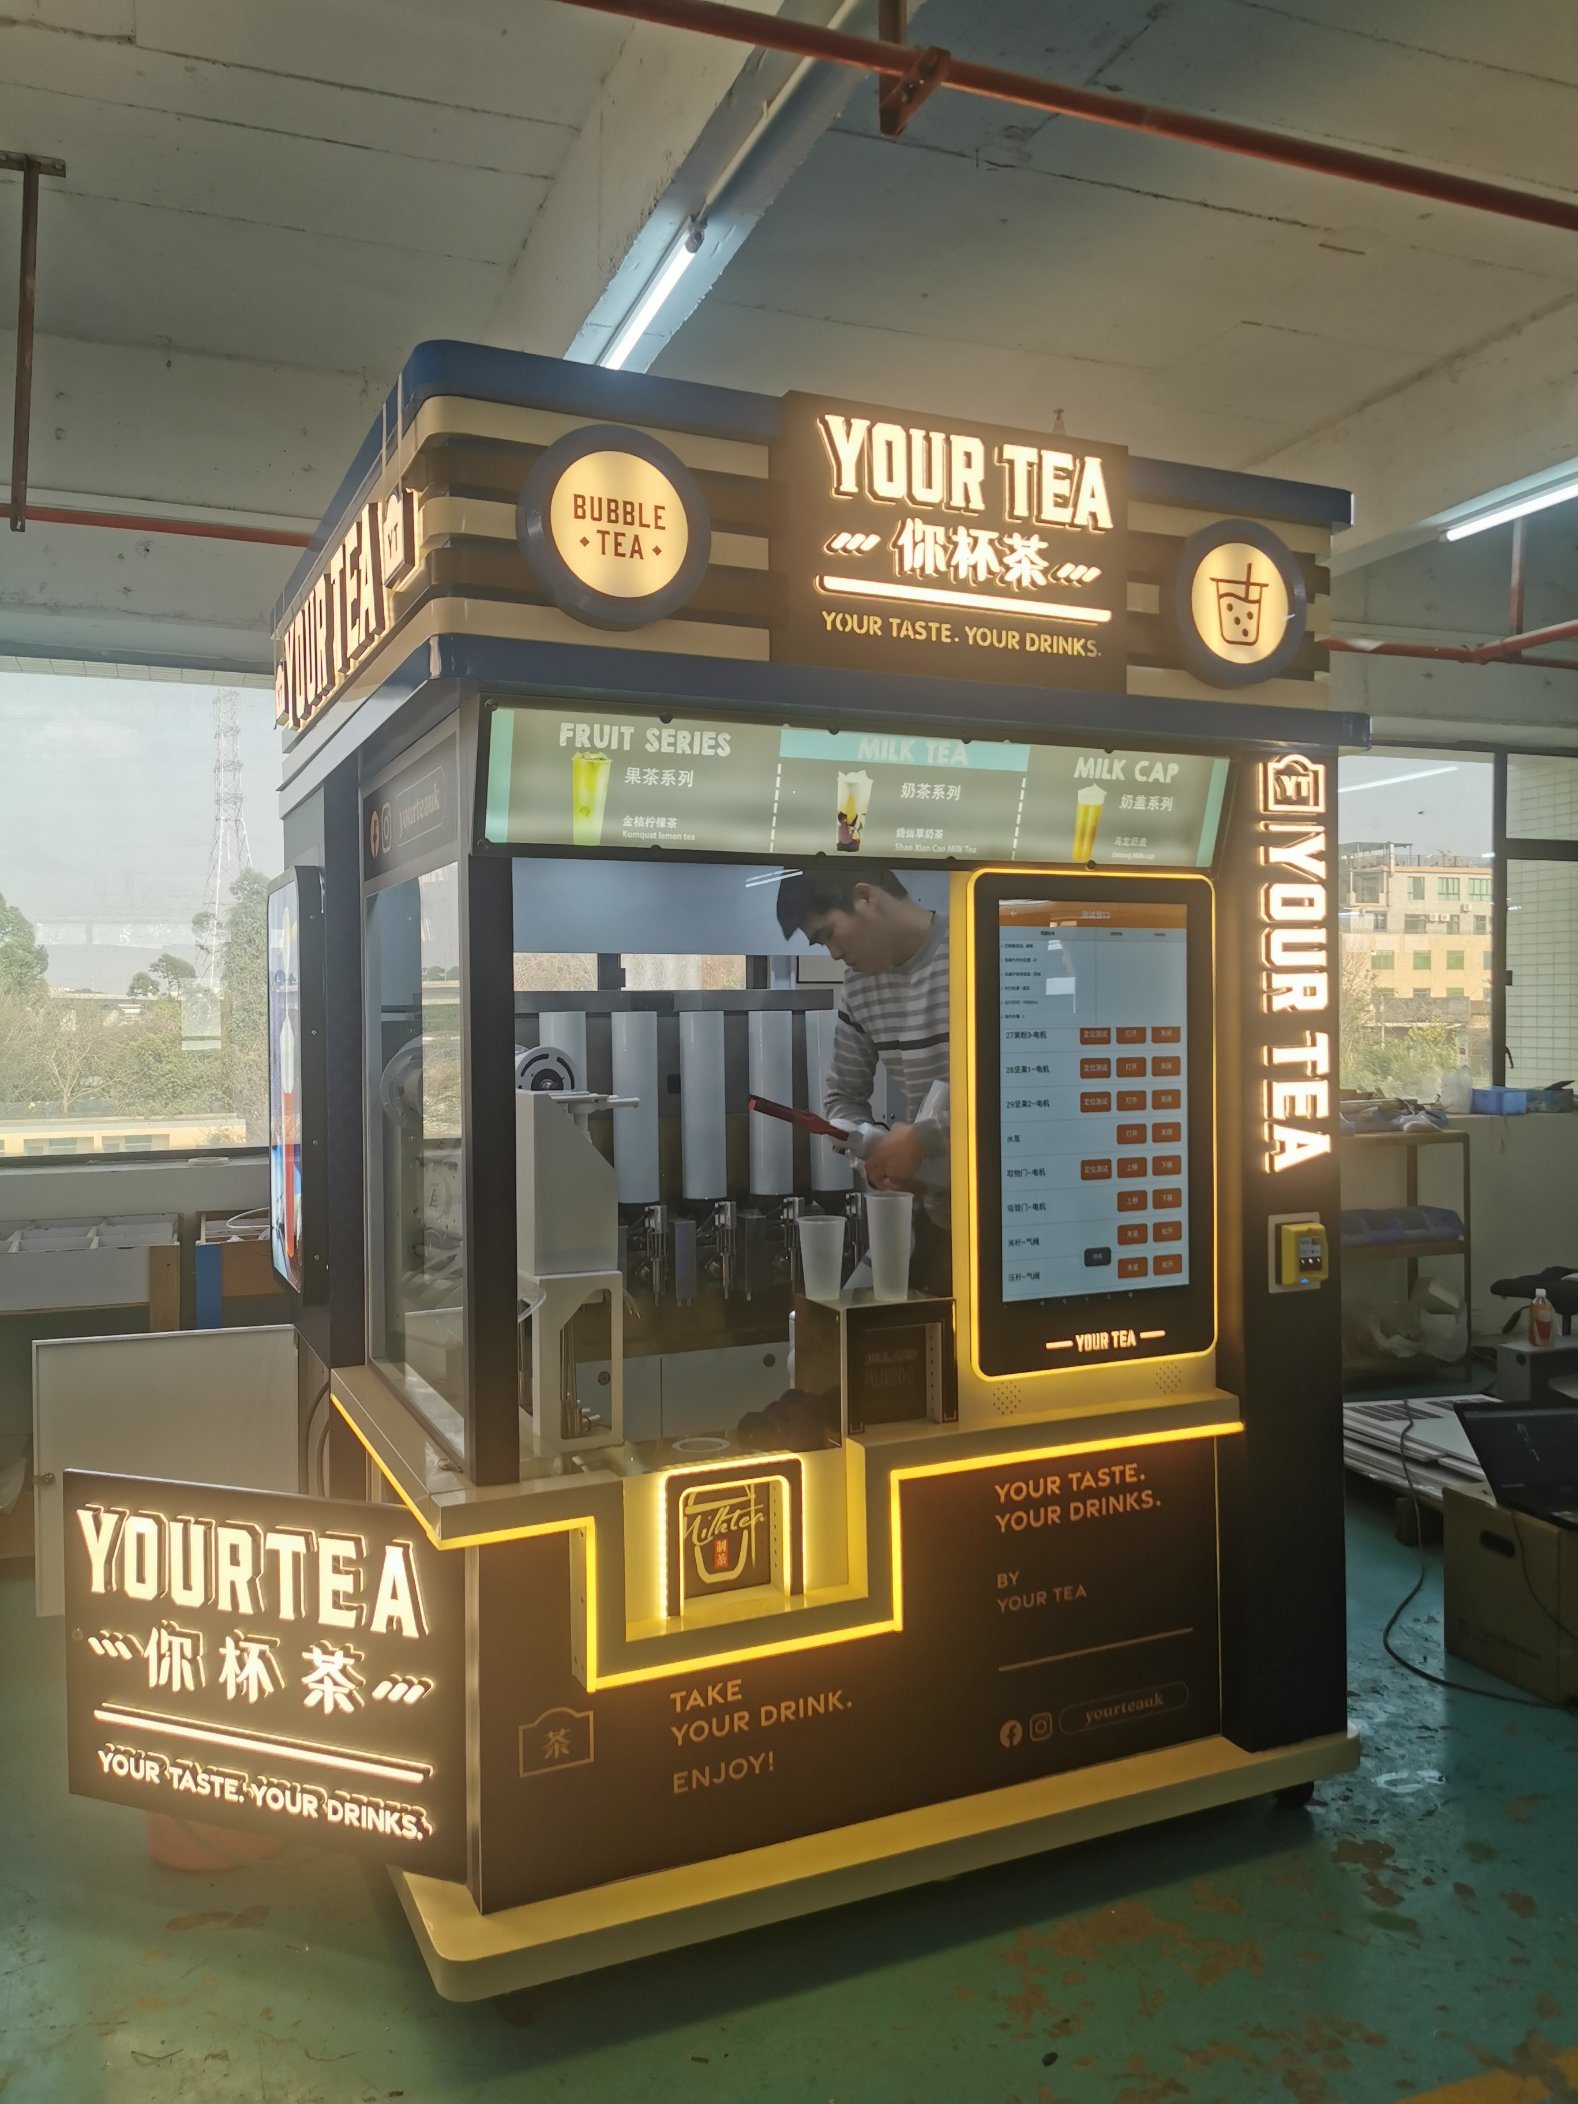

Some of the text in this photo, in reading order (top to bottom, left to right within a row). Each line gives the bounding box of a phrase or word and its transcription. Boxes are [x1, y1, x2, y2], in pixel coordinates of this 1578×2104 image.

[823, 413, 1114, 530] YOUR TEA
[573, 494, 666, 530] BUBBLE
[597, 530, 643, 560] TEA
[895, 516, 1050, 587] 你杯茶
[283, 502, 386, 730] YOUR TEA
[822, 611, 1102, 658] YOUR TASTE. YOUR DRINKS.
[559, 722, 732, 757] FRUIT SERIES
[857, 737, 969, 767] MILK TEA
[625, 767, 694, 788] 果茶系列
[1074, 756, 1179, 784] MILK CAP
[900, 781, 961, 801] 奶茶系列
[1119, 794, 1174, 812] 奶盖系列
[622, 815, 678, 830] 金桔柠檬茶
[622, 830, 696, 841] Kumquat lemon tea
[1264, 832, 1332, 1173] YOUR TEA
[1075, 1329, 1137, 1352] YOUR TEA
[995, 1463, 1145, 1503] YOUR TASTE.
[995, 1490, 1161, 1533] YOUR DRINKS.
[997, 1571, 1020, 1589] BY
[997, 1585, 1087, 1613] YOUR TEA
[670, 1679, 742, 1713] TAKE
[1085, 1694, 1164, 1727] yourteauk
[671, 1690, 853, 1746] YOUR DRINK.
[544, 1728, 570, 1759] 茶
[673, 1751, 775, 1794] ENJOY!
[98, 1748, 425, 1840] YOUR TASTE. YOUR DRINKS.
